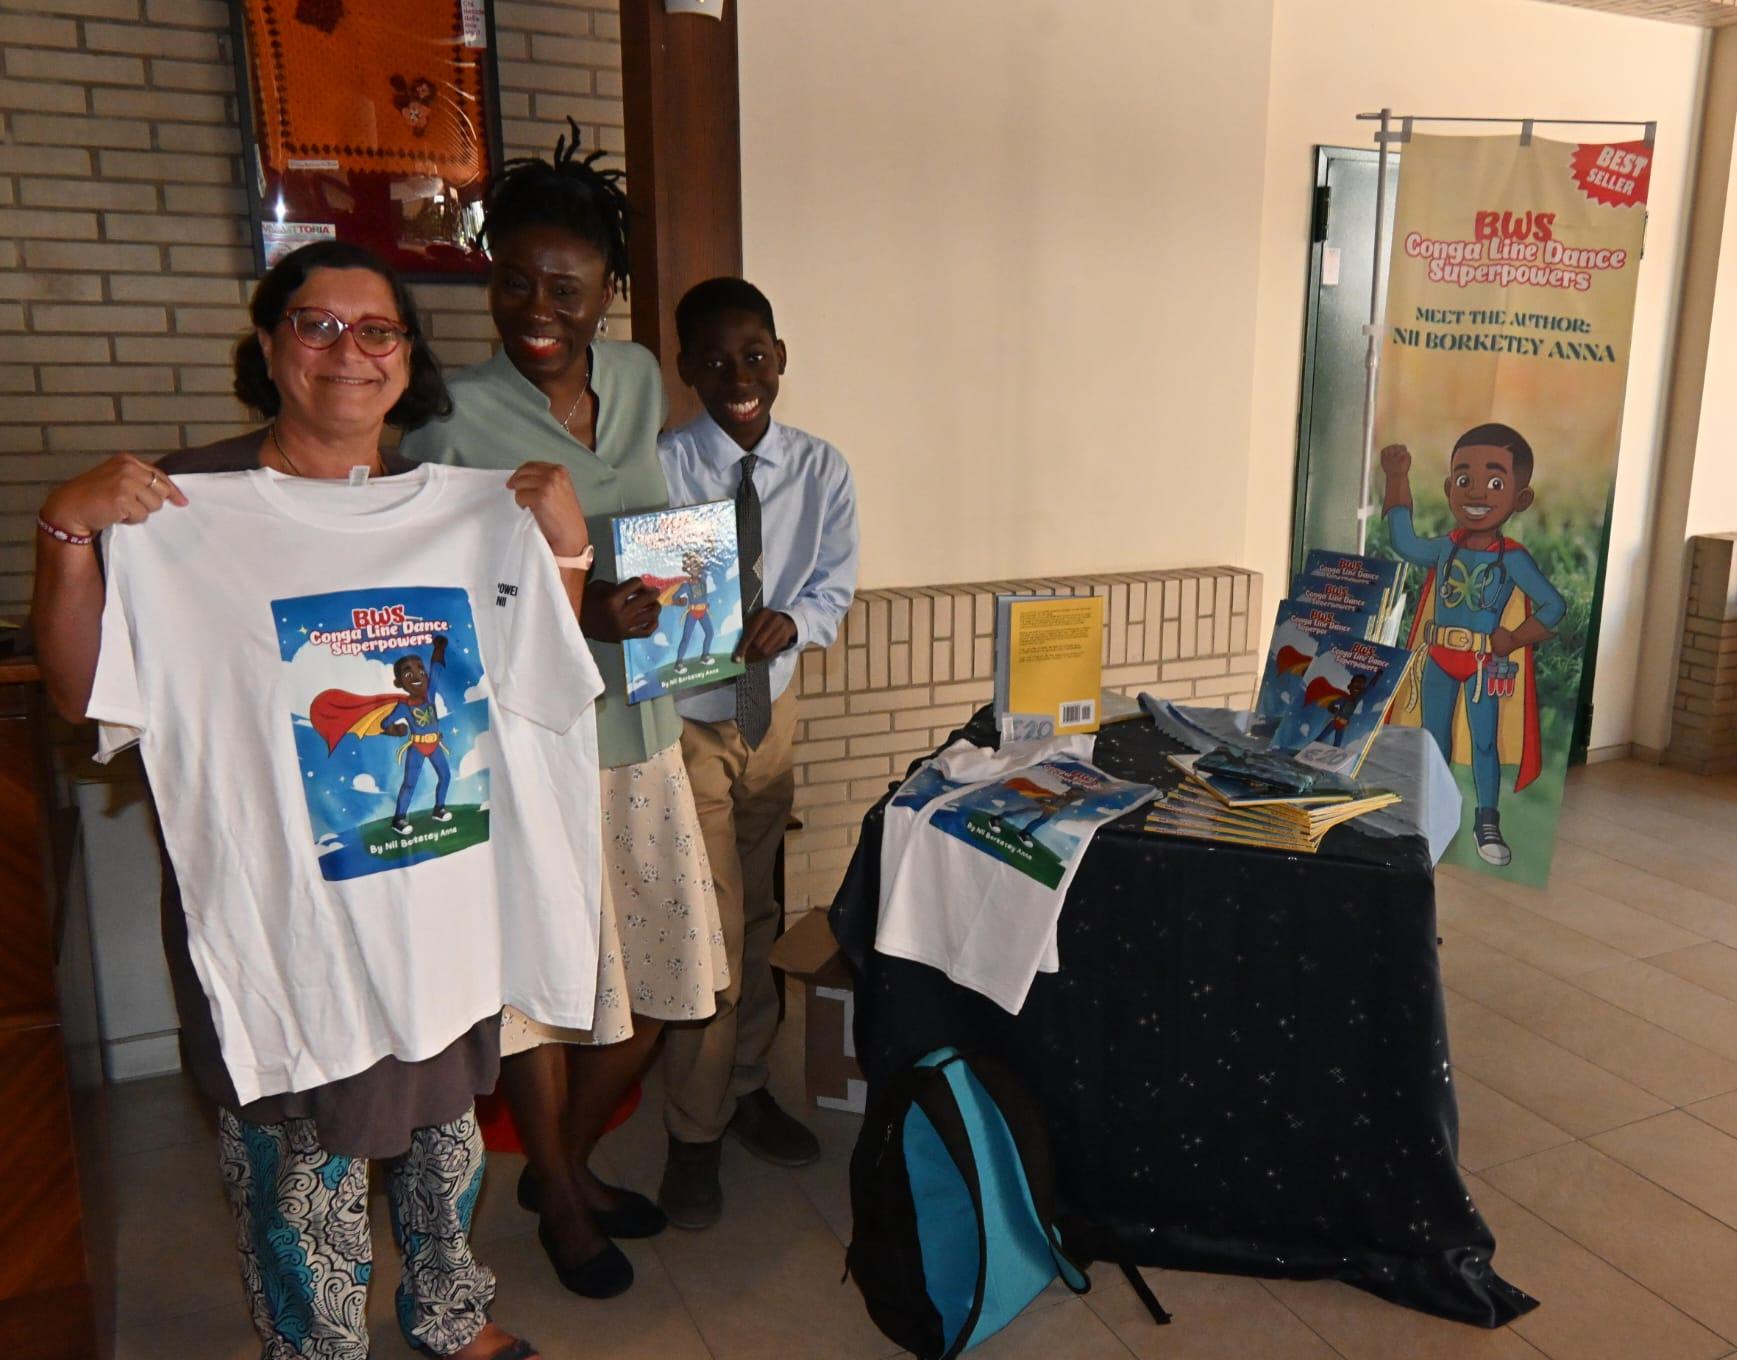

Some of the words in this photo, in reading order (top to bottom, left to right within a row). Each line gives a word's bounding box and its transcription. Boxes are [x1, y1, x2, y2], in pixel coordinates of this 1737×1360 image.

[1596, 146, 1648, 177] BEST
[1586, 168, 1635, 195] SELLER
[1475, 211, 1556, 242] BWS
[1405, 232, 1482, 262] Conga
[1487, 238, 1538, 261] Line
[1544, 240, 1627, 269] Dance
[1428, 260, 1592, 291] Superpowers
[1415, 307, 1465, 325] MEET
[1468, 311, 1506, 326] THE
[1510, 312, 1592, 333] AUTHOR:
[1393, 327, 1420, 347] NII
[1425, 333, 1544, 356] BORKETEY
[1547, 341, 1616, 363] ANNA
[352, 604, 406, 629] BWS
[309, 628, 362, 645] Conga
[366, 623, 399, 639] Line
[402, 619, 450, 635] Dance
[331, 633, 433, 656] Superpowers
[369, 844, 383, 854] By
